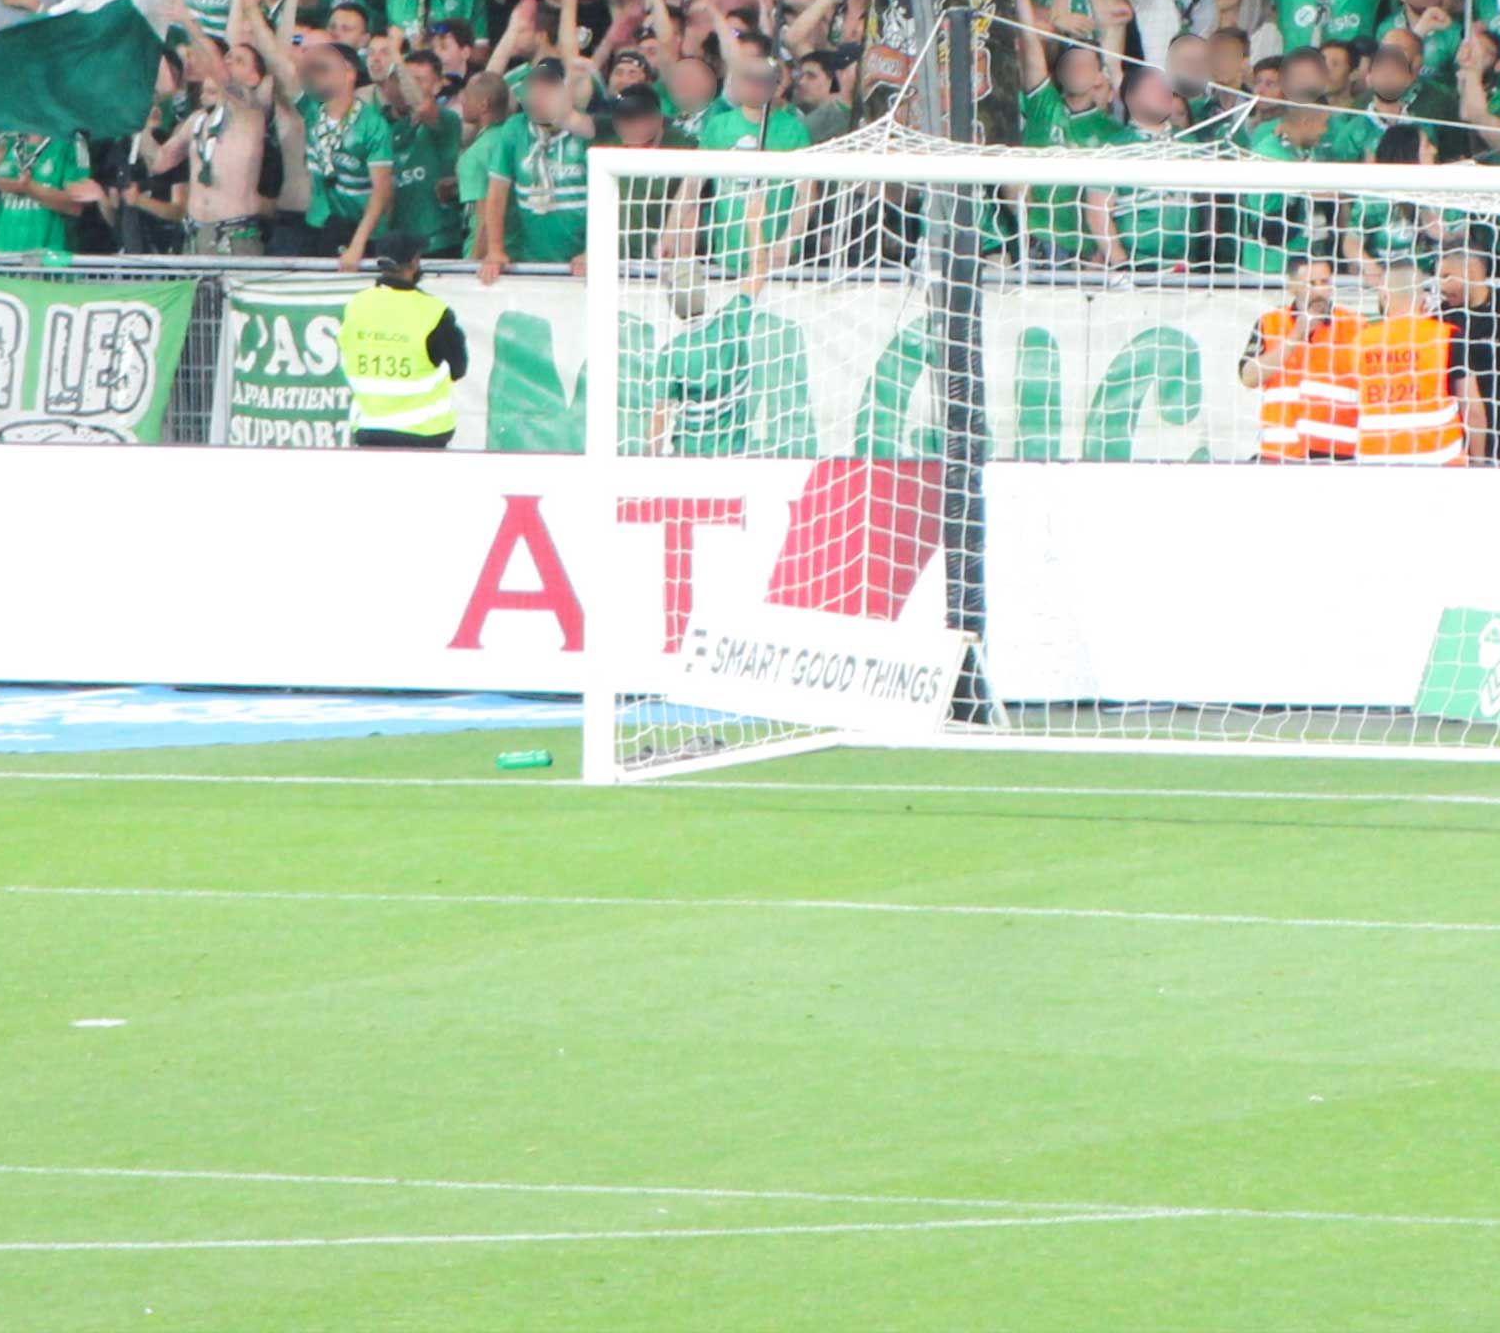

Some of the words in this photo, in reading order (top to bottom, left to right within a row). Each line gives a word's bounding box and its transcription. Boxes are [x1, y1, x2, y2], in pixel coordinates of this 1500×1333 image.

[46, 302, 154, 416] LES
[711, 635, 789, 681] SMART
[791, 648, 857, 692] GOOD
[862, 656, 943, 705] THINGS
